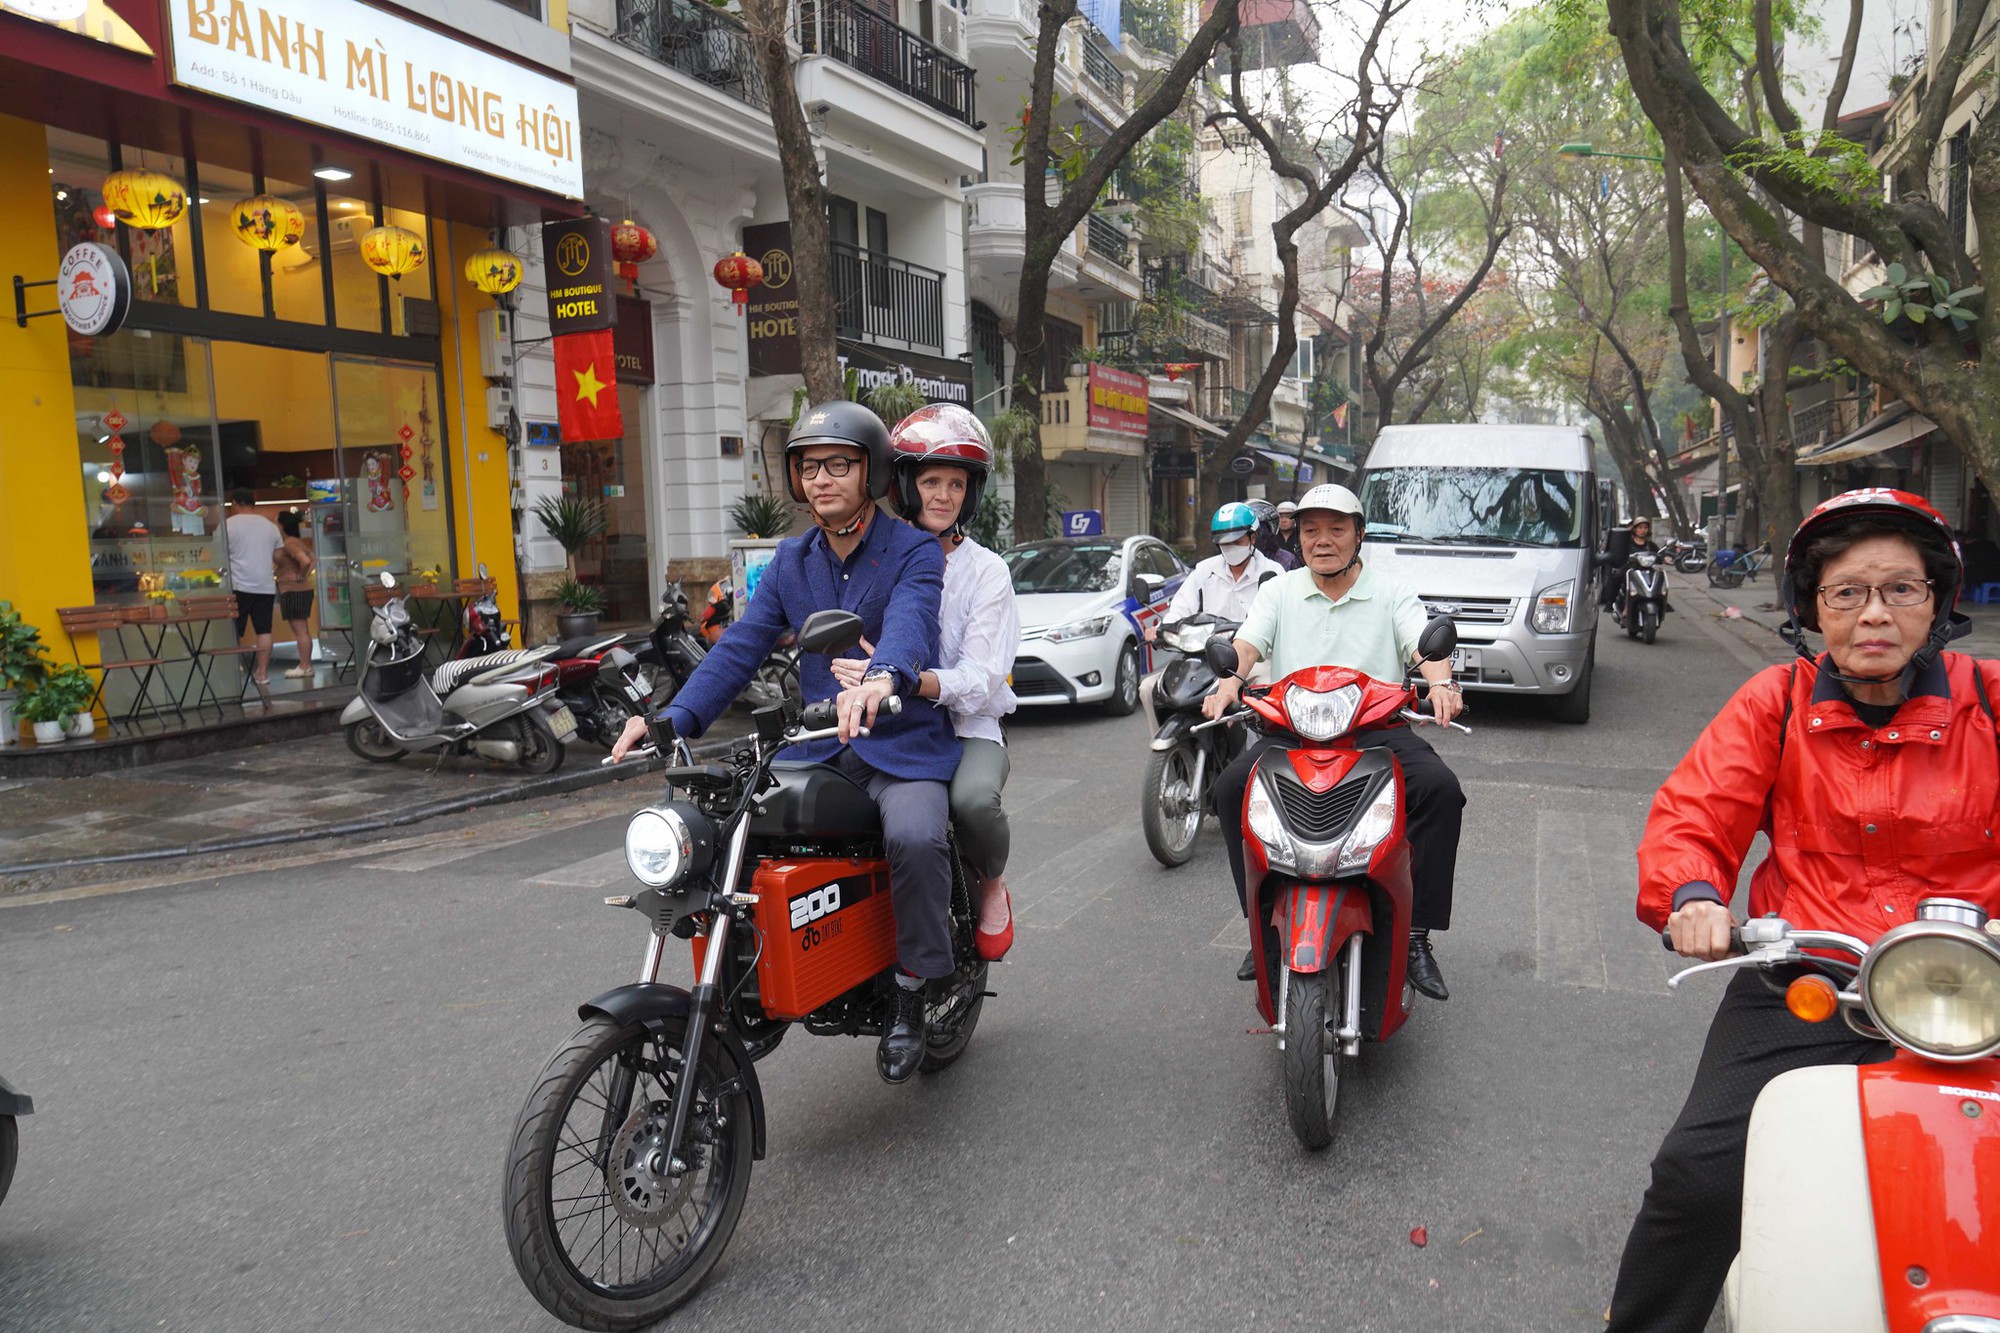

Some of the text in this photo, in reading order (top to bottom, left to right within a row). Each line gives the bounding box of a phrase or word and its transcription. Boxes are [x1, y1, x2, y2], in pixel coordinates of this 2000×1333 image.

[191, 61, 219, 79] Add:
[241, 77, 247, 88] 1
[345, 38, 390, 102] MÌ
[405, 61, 505, 140] LONG
[516, 104, 574, 168] HỘI
[334, 105, 371, 127] Hotline:
[62, 248, 103, 277] COFFEE
[550, 284, 603, 299] HM BOUTIQUE
[556, 300, 599, 319] HOTEL
[764, 300, 799, 312] BOUTIQ
[750, 318, 797, 339] HOTE
[615, 354, 642, 370] OTEL
[904, 366, 967, 402] Premium
[542, 458, 549, 471] 3
[1071, 513, 1091, 534] G7
[790, 883, 841, 930] 200
